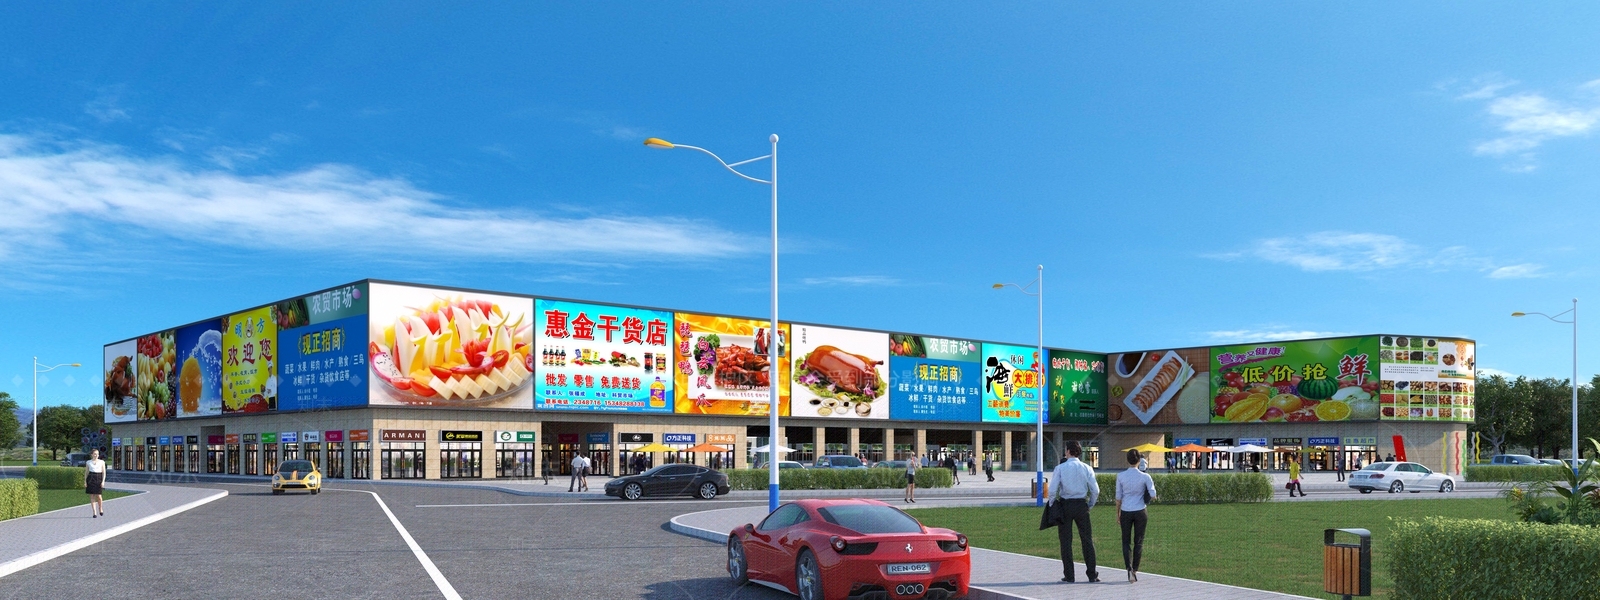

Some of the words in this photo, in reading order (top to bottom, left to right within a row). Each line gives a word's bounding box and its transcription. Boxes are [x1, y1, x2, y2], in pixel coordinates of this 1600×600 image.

[312, 287, 352, 315] 农贸市场
[544, 310, 668, 346] 惠金干货店
[226, 338, 273, 366] 欢迎您
[929, 338, 968, 355] 农贸市场
[545, 373, 567, 387] 批发
[573, 374, 595, 388] 零售
[600, 375, 642, 389] 免费送货
